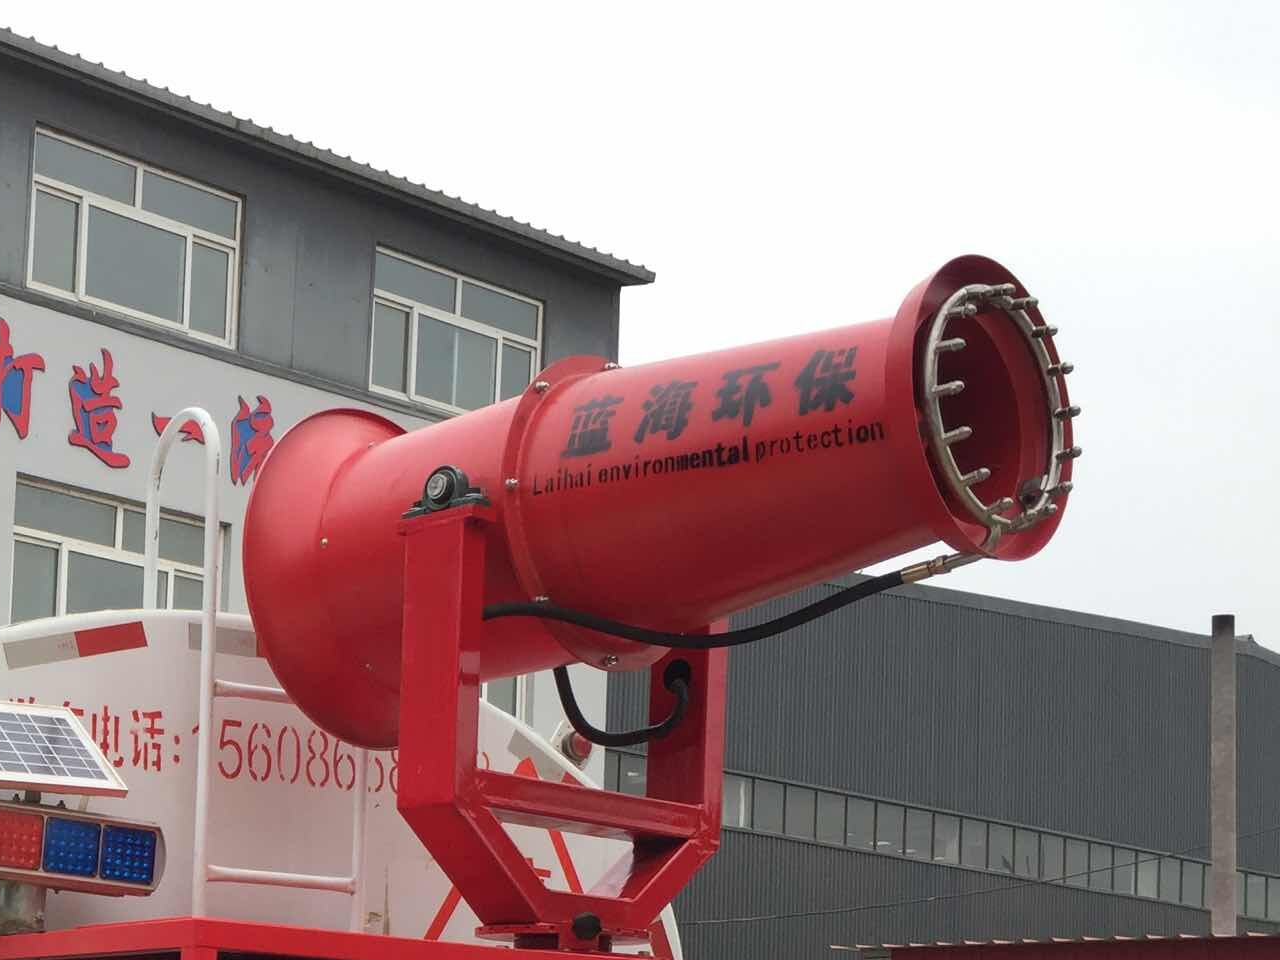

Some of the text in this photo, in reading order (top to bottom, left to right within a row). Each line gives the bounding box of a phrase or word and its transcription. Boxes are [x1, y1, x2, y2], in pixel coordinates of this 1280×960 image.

[560, 346, 859, 458] 蓝海环保
[532, 419, 885, 496] Laihai environmental protection
